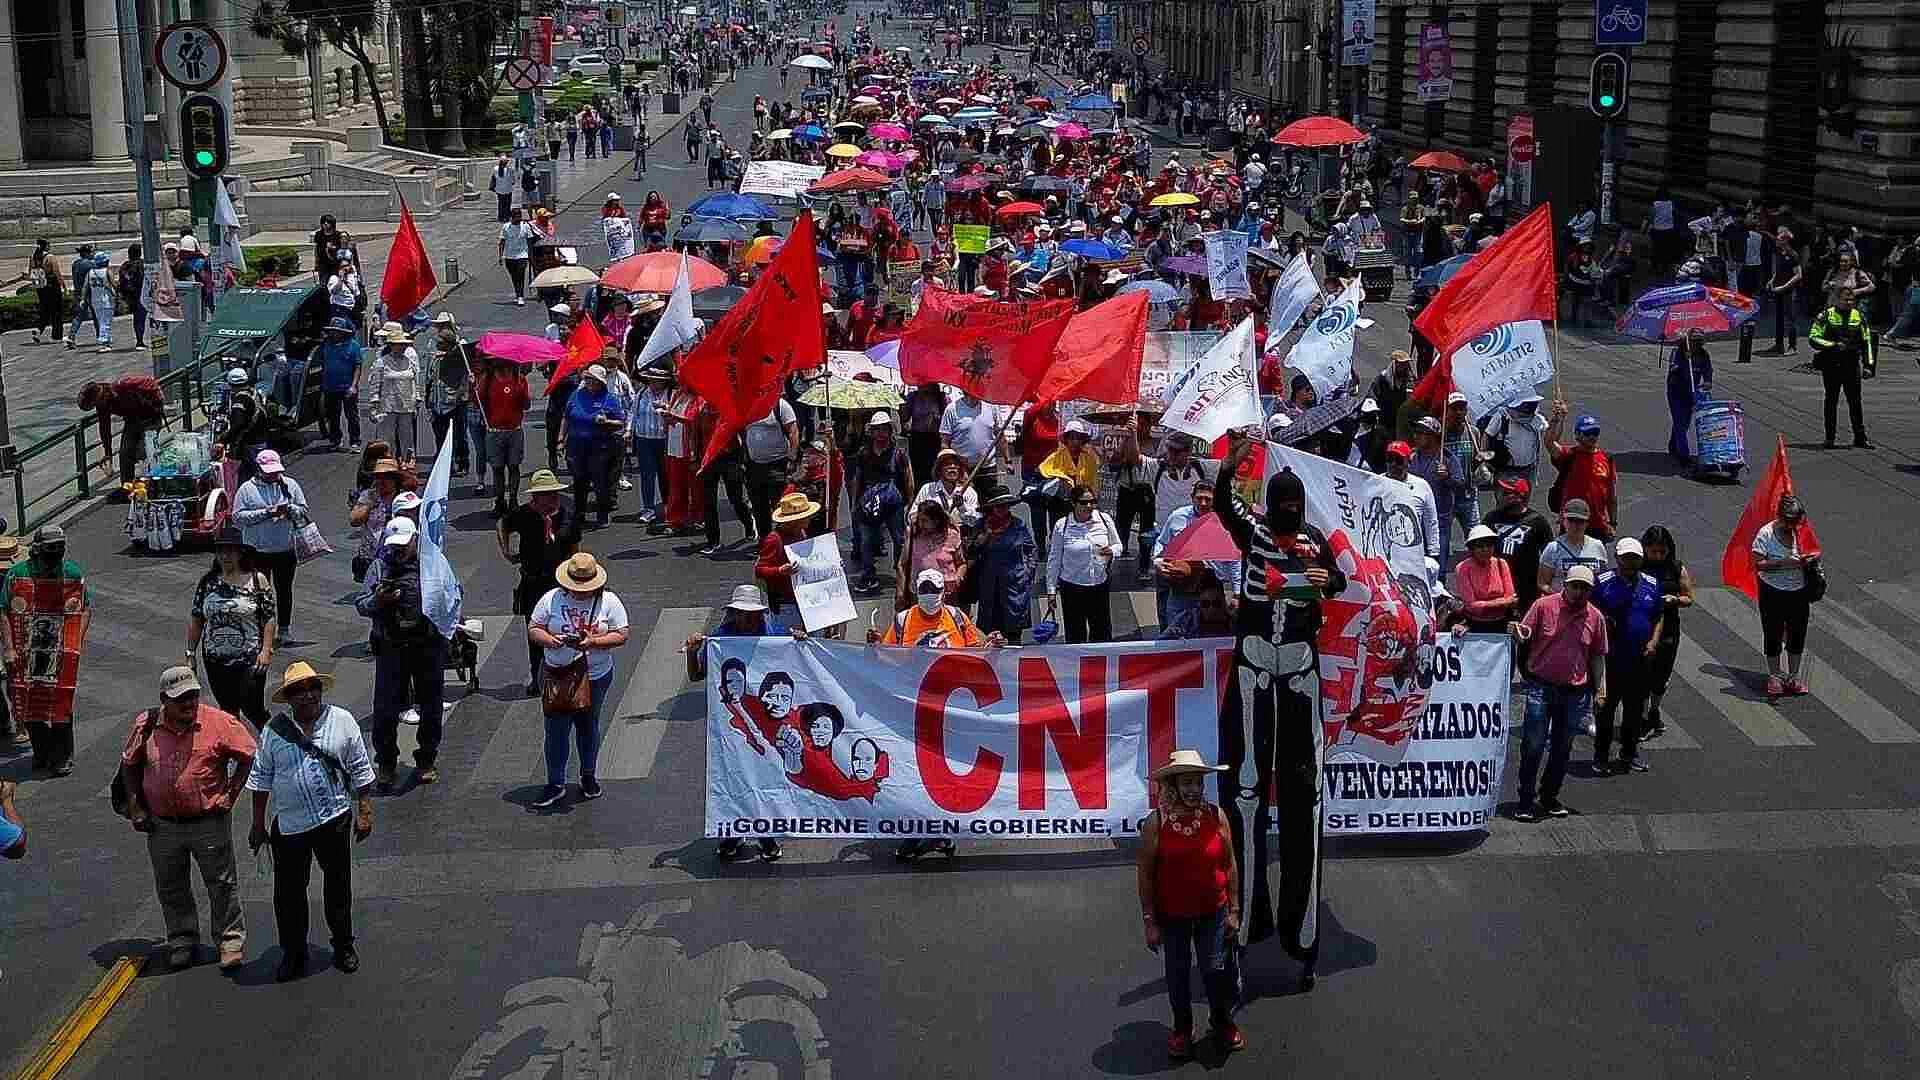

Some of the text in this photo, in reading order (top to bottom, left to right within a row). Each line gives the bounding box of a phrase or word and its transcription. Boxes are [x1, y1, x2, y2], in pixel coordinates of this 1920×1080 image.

[878, 819, 960, 834] QUIEN
[970, 818, 1112, 837] GOBIERNE,
[1327, 813, 1359, 829] SE
